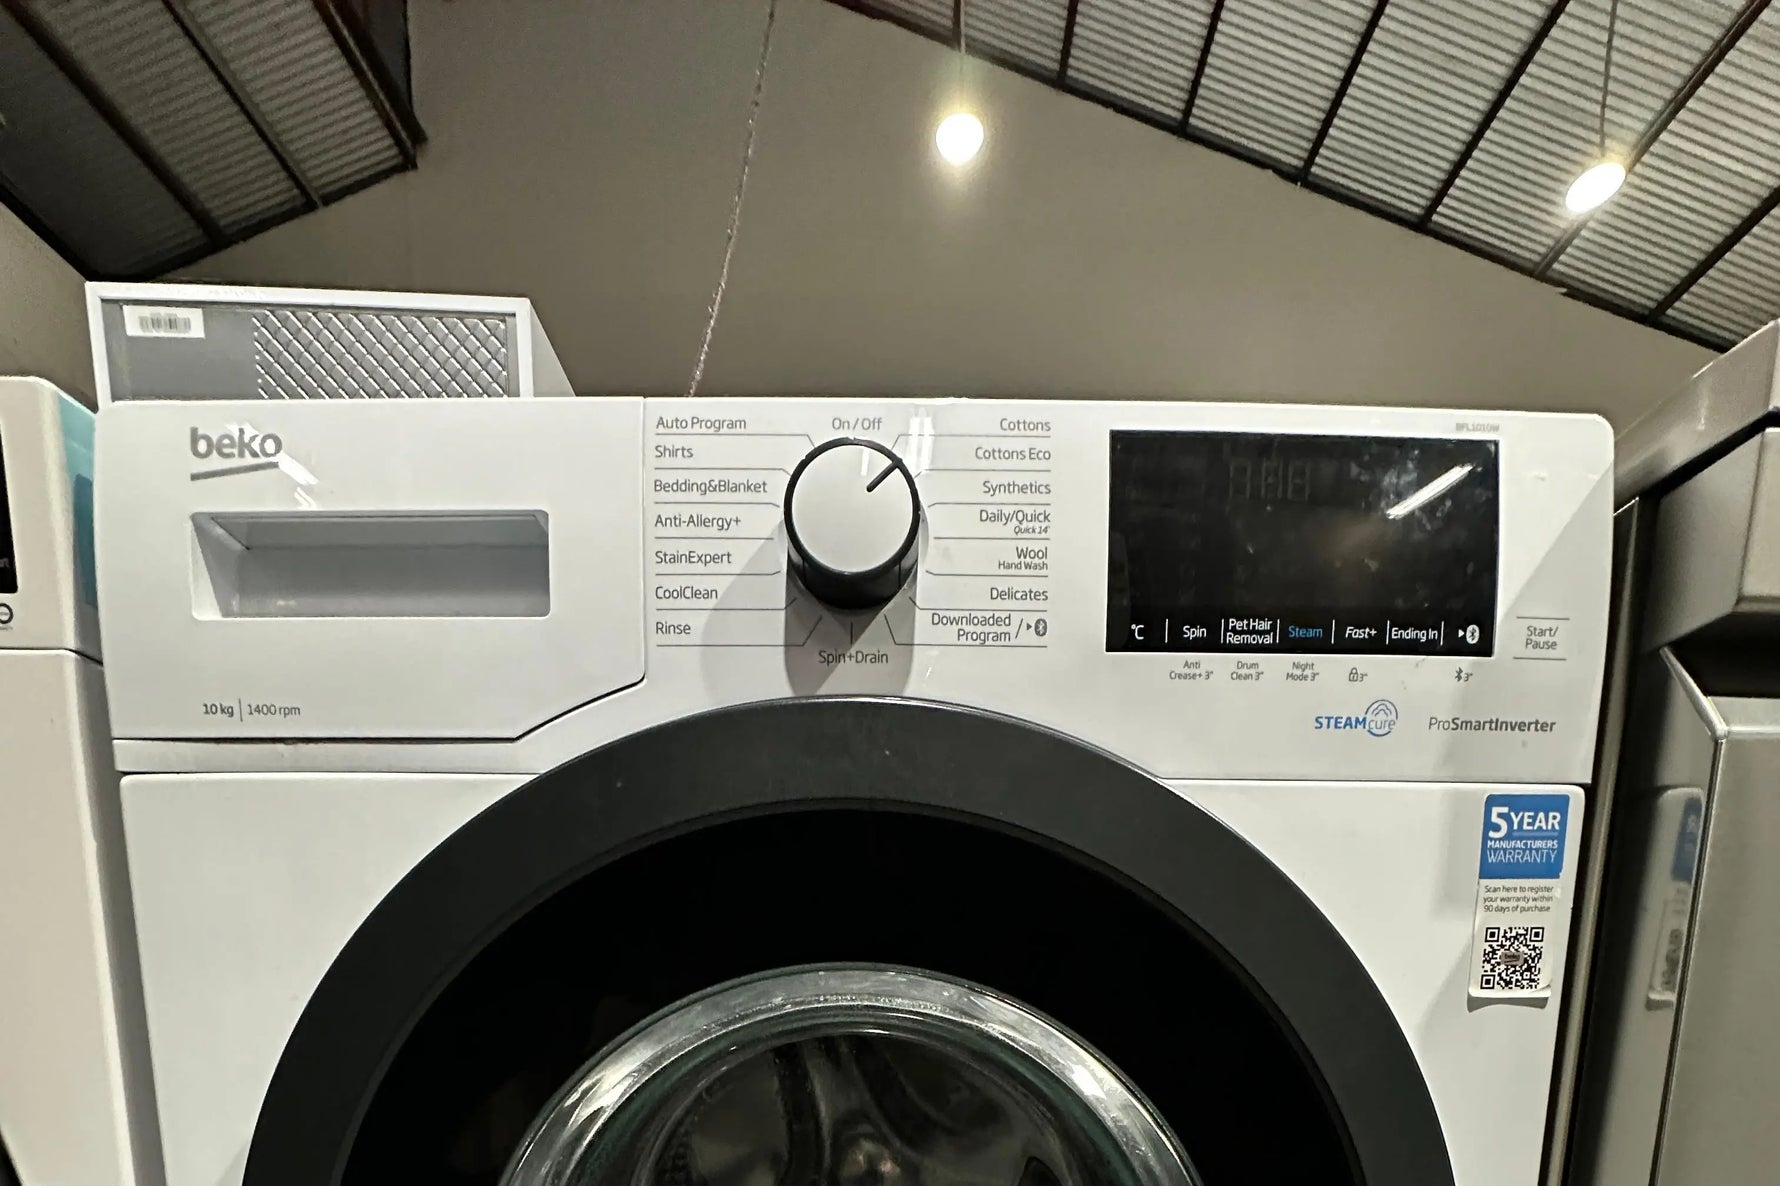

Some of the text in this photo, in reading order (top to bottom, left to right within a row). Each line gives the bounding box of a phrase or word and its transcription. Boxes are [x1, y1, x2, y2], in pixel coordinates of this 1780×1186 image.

[656, 417, 746, 432] Auto Program
[832, 418, 850, 430] On
[861, 417, 882, 430] Off
[1000, 419, 1051, 431] Cottons
[190, 427, 282, 459] beko
[655, 445, 693, 458] Shirts
[975, 447, 1051, 460] Cottons Eco
[654, 480, 767, 495] Bedding&Blanket
[983, 482, 1051, 496] Synthetics
[655, 515, 741, 530] Anti-Allergy+
[980, 510, 1050, 524] Daily/Quick
[1014, 526, 1036, 536] Quick
[655, 550, 732, 566] StainExpert
[1016, 547, 1048, 560] Wool
[998, 561, 1048, 570] Hand Wash
[655, 586, 718, 599] CoolClean
[990, 587, 1048, 600] Delicates
[931, 613, 1011, 627] Downloaded
[1229, 618, 1272, 630] Pet Hair
[656, 622, 691, 634] Rinse
[1183, 625, 1207, 641] Spin
[1289, 625, 1323, 639] Steam
[1345, 626, 1377, 639] Fast+
[1527, 626, 1558, 639] Start/
[957, 629, 1011, 644] Program
[1226, 631, 1273, 644] Removal
[1392, 627, 1438, 643] Ending In
[1526, 638, 1557, 650] Pause
[818, 650, 888, 665] Spin+Drain
[1183, 661, 1200, 669] Anti
[1237, 661, 1259, 669] Drum
[1292, 662, 1314, 672] Night
[1169, 671, 1203, 680] Crease+
[1231, 671, 1253, 680] Clean
[1286, 672, 1309, 681] Mode
[203, 702, 234, 718] 10 kg
[248, 703, 300, 718] 1400 rpm
[1428, 717, 1556, 733] ProSmartInverter
[1488, 806, 1560, 838] 5 YEAR
[1487, 840, 1558, 849] MANUFACTURERS
[1487, 849, 1557, 863] WARRANTY
[1485, 885, 1500, 893] Scan
[1527, 886, 1554, 895] register
[1500, 896, 1530, 904] warranty
[1494, 905, 1510, 913] days
[1520, 905, 1551, 913] purchase
